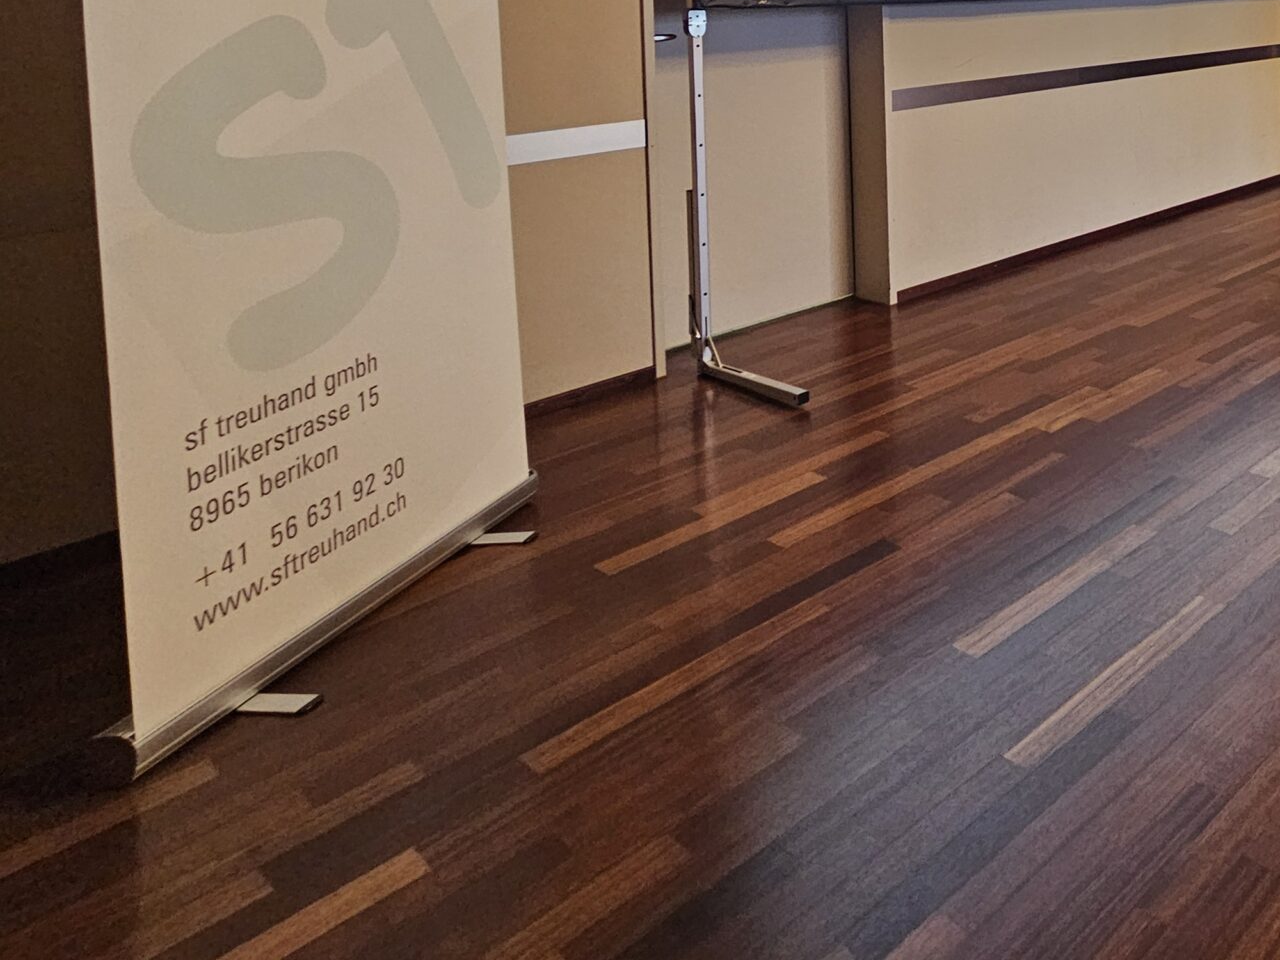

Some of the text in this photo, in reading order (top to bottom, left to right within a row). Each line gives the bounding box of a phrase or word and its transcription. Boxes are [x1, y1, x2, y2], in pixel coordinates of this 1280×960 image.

[184, 352, 378, 452] sf treuhand gmbh
[187, 385, 380, 493] bellikerstrasse 15
[189, 443, 339, 532] 8965 berikon
[194, 456, 405, 587] +41 56 631 92 30
[193, 491, 407, 632] www.sftreuhand.ch
